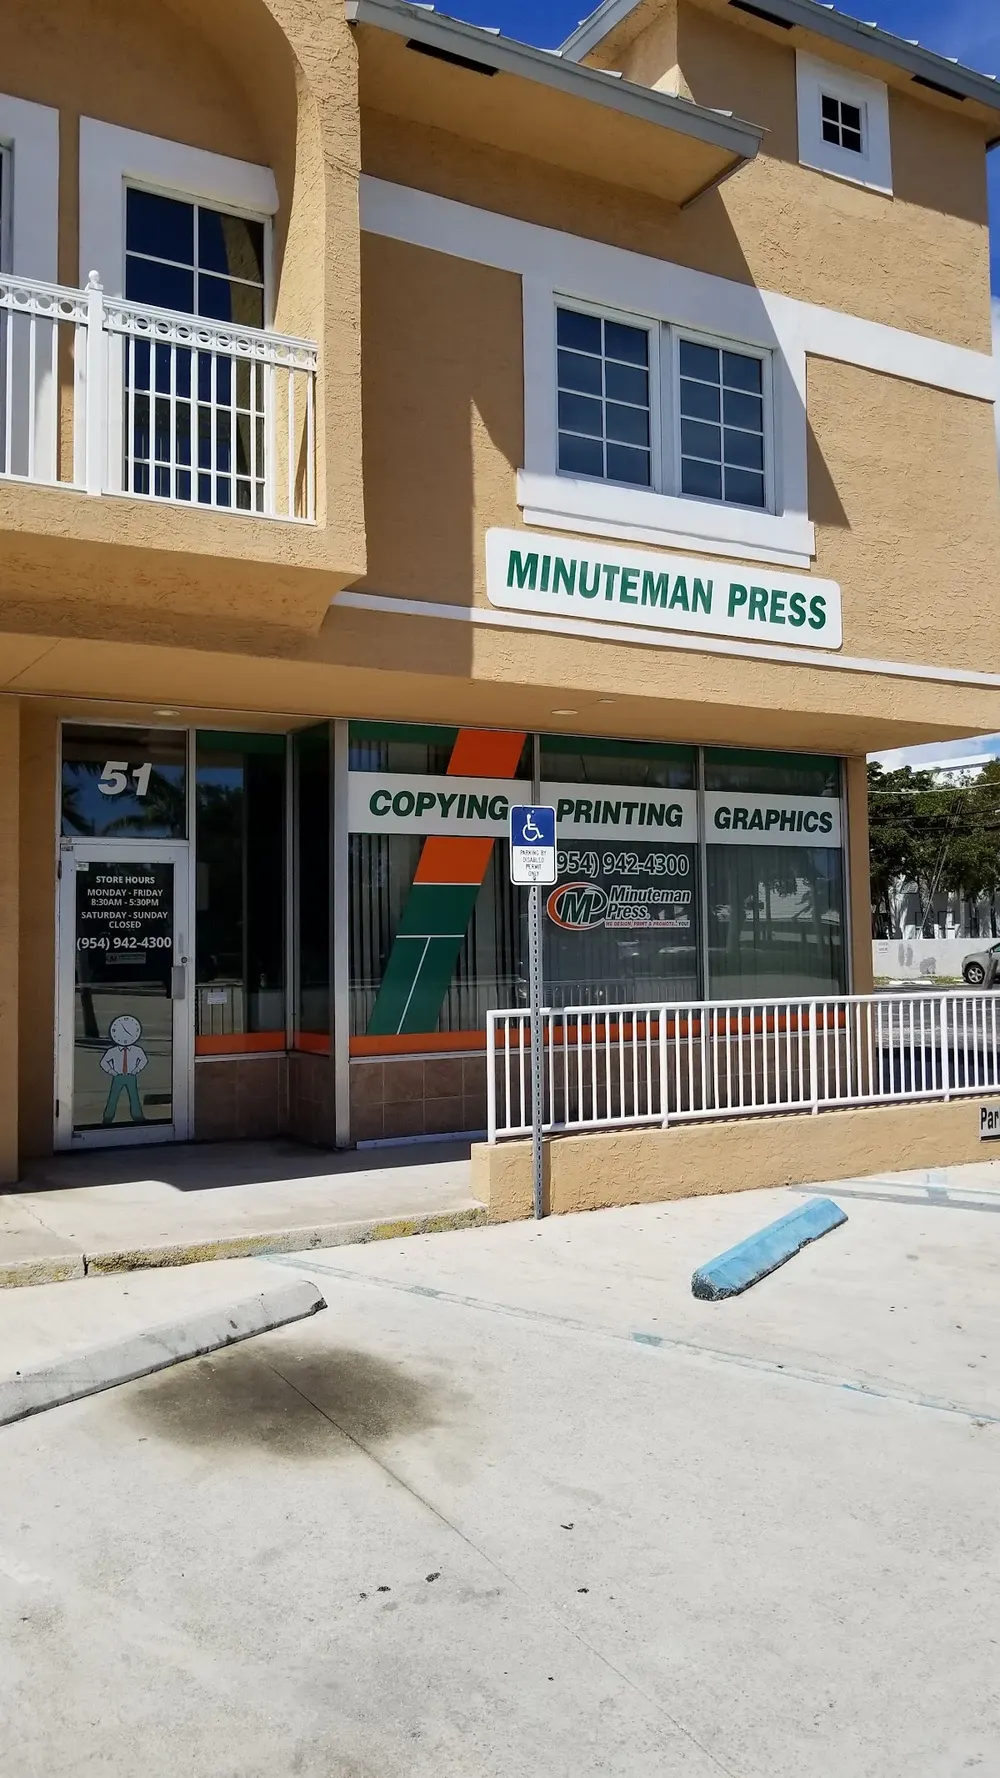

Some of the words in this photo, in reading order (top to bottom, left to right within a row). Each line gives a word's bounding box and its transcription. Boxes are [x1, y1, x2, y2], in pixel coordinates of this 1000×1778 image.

[507, 550, 713, 614] MINUTEMAN
[727, 583, 827, 630] PRESS
[97, 761, 152, 796] 51
[369, 789, 509, 820] COPYING
[556, 798, 683, 828] PRINTING
[714, 806, 833, 833] GRAPHICS
[557, 850, 599, 878] 954)
[603, 852, 690, 877] 942-4300
[96, 876, 123, 884] STORE
[125, 876, 155, 884] HOURS
[87, 889, 127, 897] MONDAY
[133, 889, 163, 897] FRIDAY
[91, 898, 122, 906] 8:30AM
[129, 898, 159, 906] 5:30PM
[608, 885, 691, 904] Minuteman
[81, 911, 127, 919] SATURDAY
[133, 911, 168, 919] SUNDAY
[109, 921, 141, 929] CLOSED
[77, 936, 110, 951] (954)
[113, 937, 172, 949] 942-4300
[980, 1107, 1000, 1130] Par
